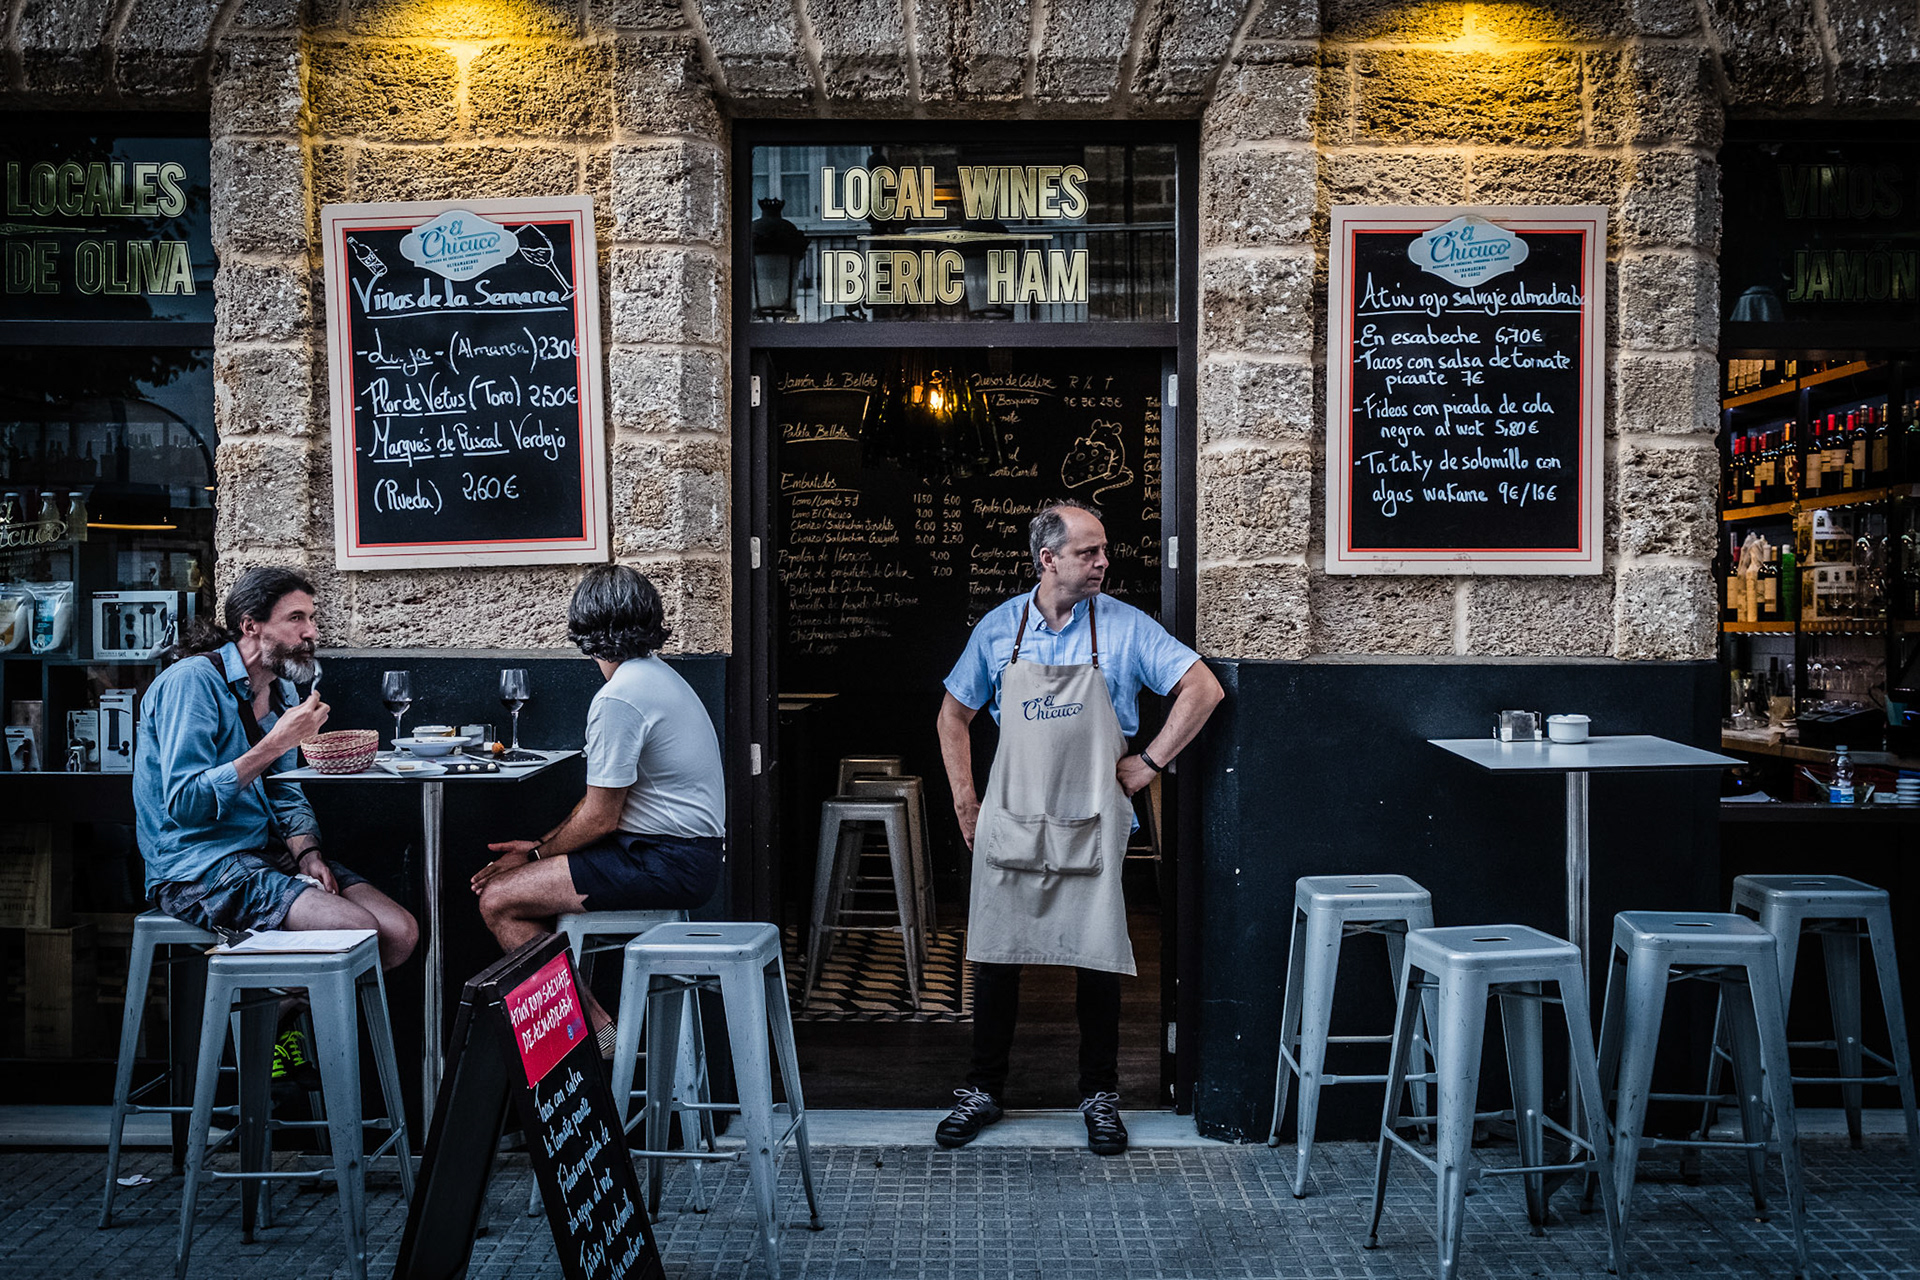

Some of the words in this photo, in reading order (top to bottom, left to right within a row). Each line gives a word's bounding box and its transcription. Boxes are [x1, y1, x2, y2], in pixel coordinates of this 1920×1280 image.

[6, 161, 187, 217] LOCALES
[821, 165, 947, 221] LOCAL
[957, 164, 1090, 220] WINES
[1777, 163, 1903, 220] VINOS
[419, 226, 500, 258] Chicuco
[449, 220, 463, 236] El
[1459, 225, 1475, 241] El
[1427, 230, 1511, 263] Chicuco
[5, 240, 60, 295] DE
[75, 240, 196, 295] OLIVA
[821, 249, 965, 305] IBERIC
[987, 249, 1090, 305] HAM
[1787, 240, 1918, 302] JAMÓN
[352, 273, 417, 314] Vinos
[416, 278, 441, 307] de
[445, 279, 469, 308] la
[474, 280, 562, 305] Semana
[1358, 272, 1415, 309] Atún
[1419, 293, 1448, 318] rojo
[1452, 288, 1508, 317] salvaje
[1361, 324, 1386, 347] En
[1391, 324, 1481, 345] escabeche
[1360, 348, 1404, 371] Tacos
[1407, 354, 1434, 370] con
[1439, 349, 1484, 368] salsa
[1489, 345, 1511, 368] de
[361, 377, 401, 415] Flor
[403, 383, 422, 411] de
[418, 372, 466, 413] Vetus
[469, 375, 520, 410] (Toro)
[777, 371, 819, 391] Jamón
[823, 372, 839, 388] de
[1385, 370, 1448, 394] picante
[1461, 372, 1485, 386] 7€
[1363, 393, 1409, 419] Fideos
[1413, 404, 1439, 417] con
[1443, 393, 1493, 422] picada
[1499, 393, 1518, 414] de
[1522, 392, 1555, 414] cola
[437, 424, 456, 452] de
[509, 413, 566, 461] Verdejo
[1380, 423, 1425, 448] negra
[1435, 421, 1451, 436] al
[1456, 420, 1484, 437] wok
[1439, 449, 1459, 470] de
[1461, 446, 1528, 470] solomillo
[1536, 458, 1562, 470] con
[780, 471, 837, 490] Embutidos
[374, 479, 443, 515] (Rueda)
[1372, 478, 1414, 518] algas
[1021, 698, 1083, 721] Chicuco
[1044, 695, 1055, 707] El
